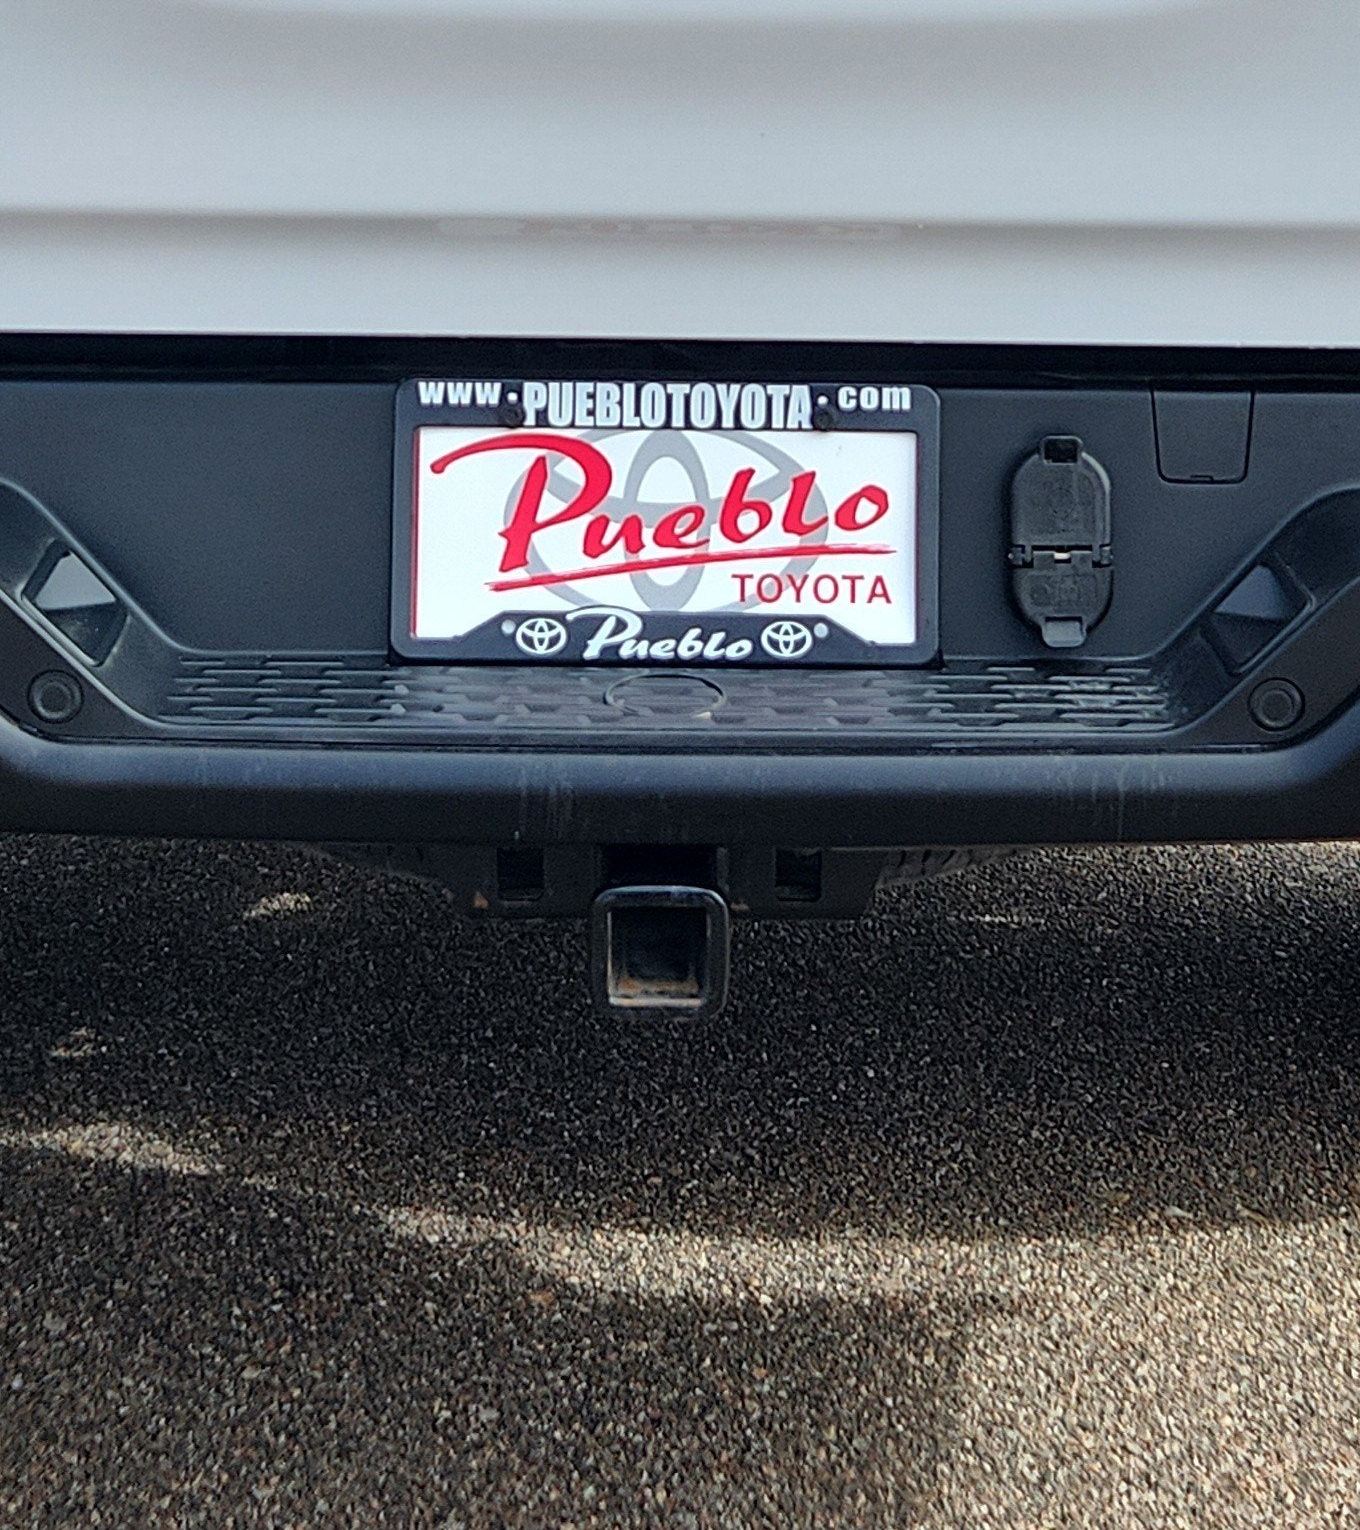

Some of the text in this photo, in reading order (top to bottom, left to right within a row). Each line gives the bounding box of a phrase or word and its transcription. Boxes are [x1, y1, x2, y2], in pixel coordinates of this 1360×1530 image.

[430, 432, 889, 572] Pueblo
[732, 574, 892, 604] TOYOTA
[566, 605, 753, 660] Pueblo
